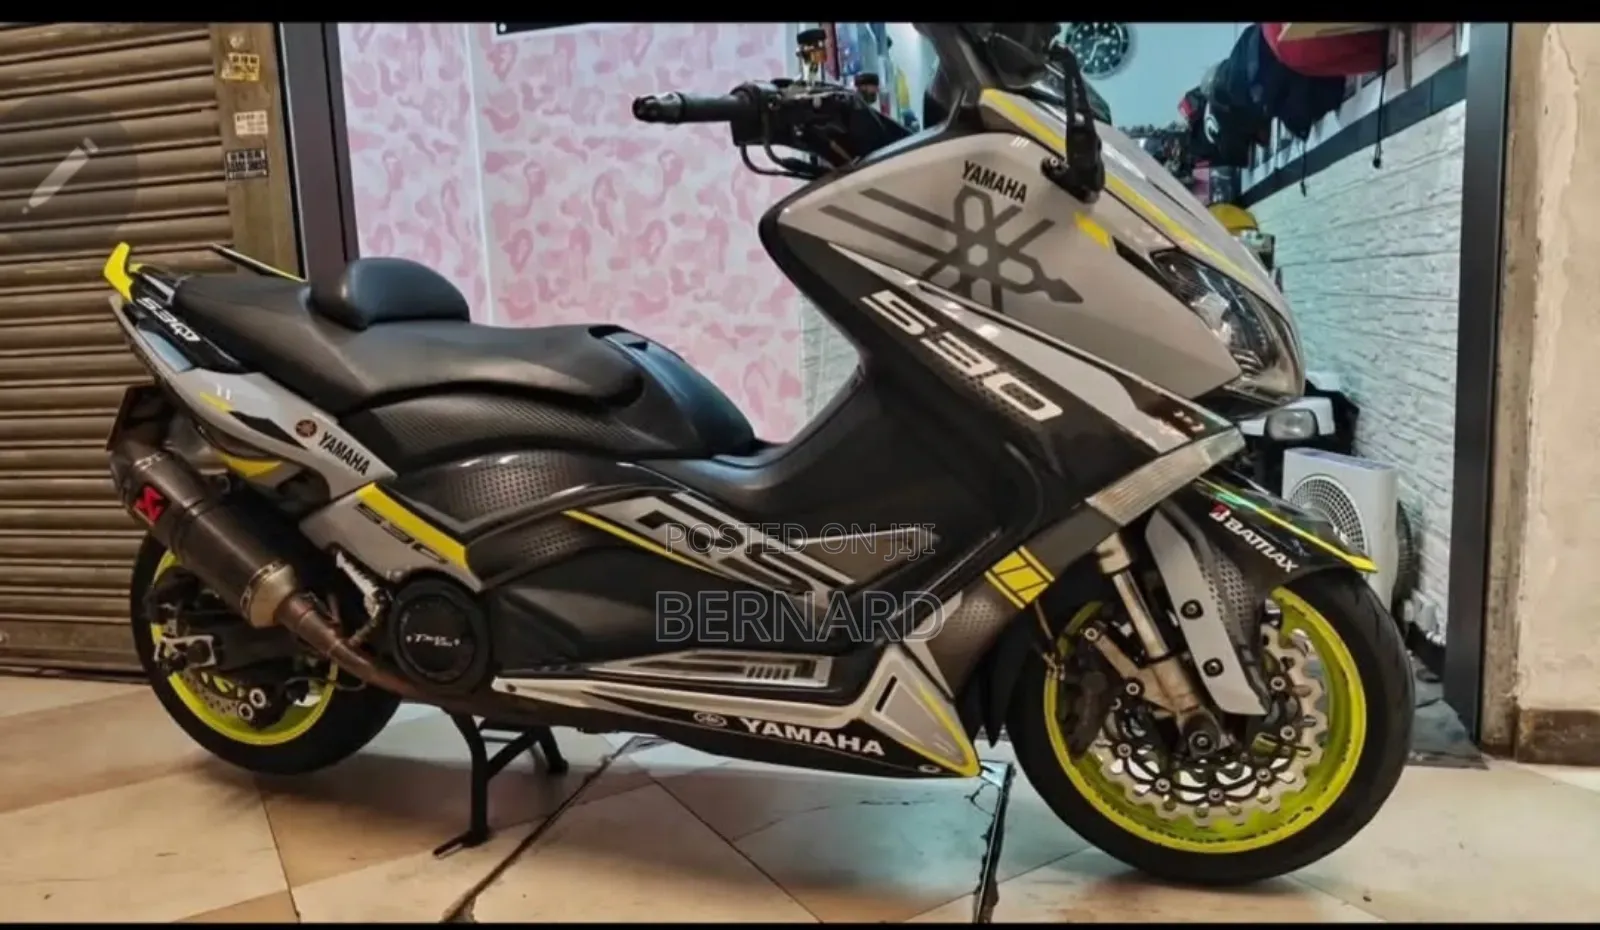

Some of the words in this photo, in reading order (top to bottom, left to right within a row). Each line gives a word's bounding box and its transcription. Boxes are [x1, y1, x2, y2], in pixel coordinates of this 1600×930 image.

[962, 160, 1027, 203] YAMAHA
[860, 289, 1064, 421] 530
[318, 431, 370, 476] YAMAHA
[739, 717, 885, 756] YAMAHA
